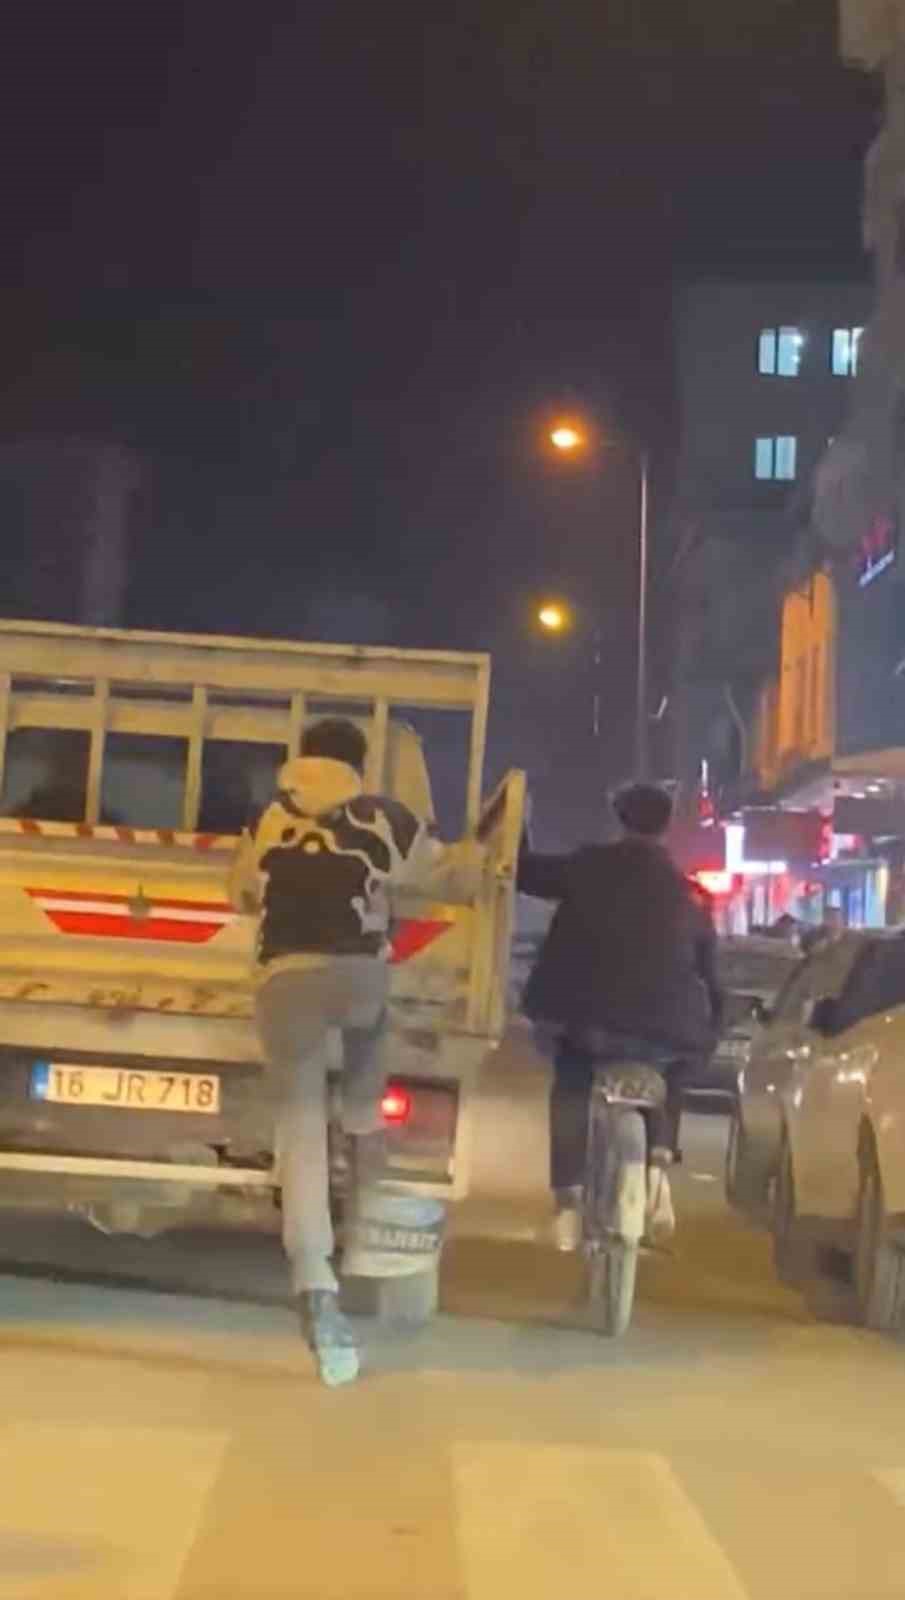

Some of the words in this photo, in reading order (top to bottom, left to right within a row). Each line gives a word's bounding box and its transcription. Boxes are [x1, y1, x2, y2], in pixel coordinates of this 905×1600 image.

[54, 1071, 85, 1097] 16
[102, 1072, 146, 1102] JR
[159, 1076, 214, 1107] 718
